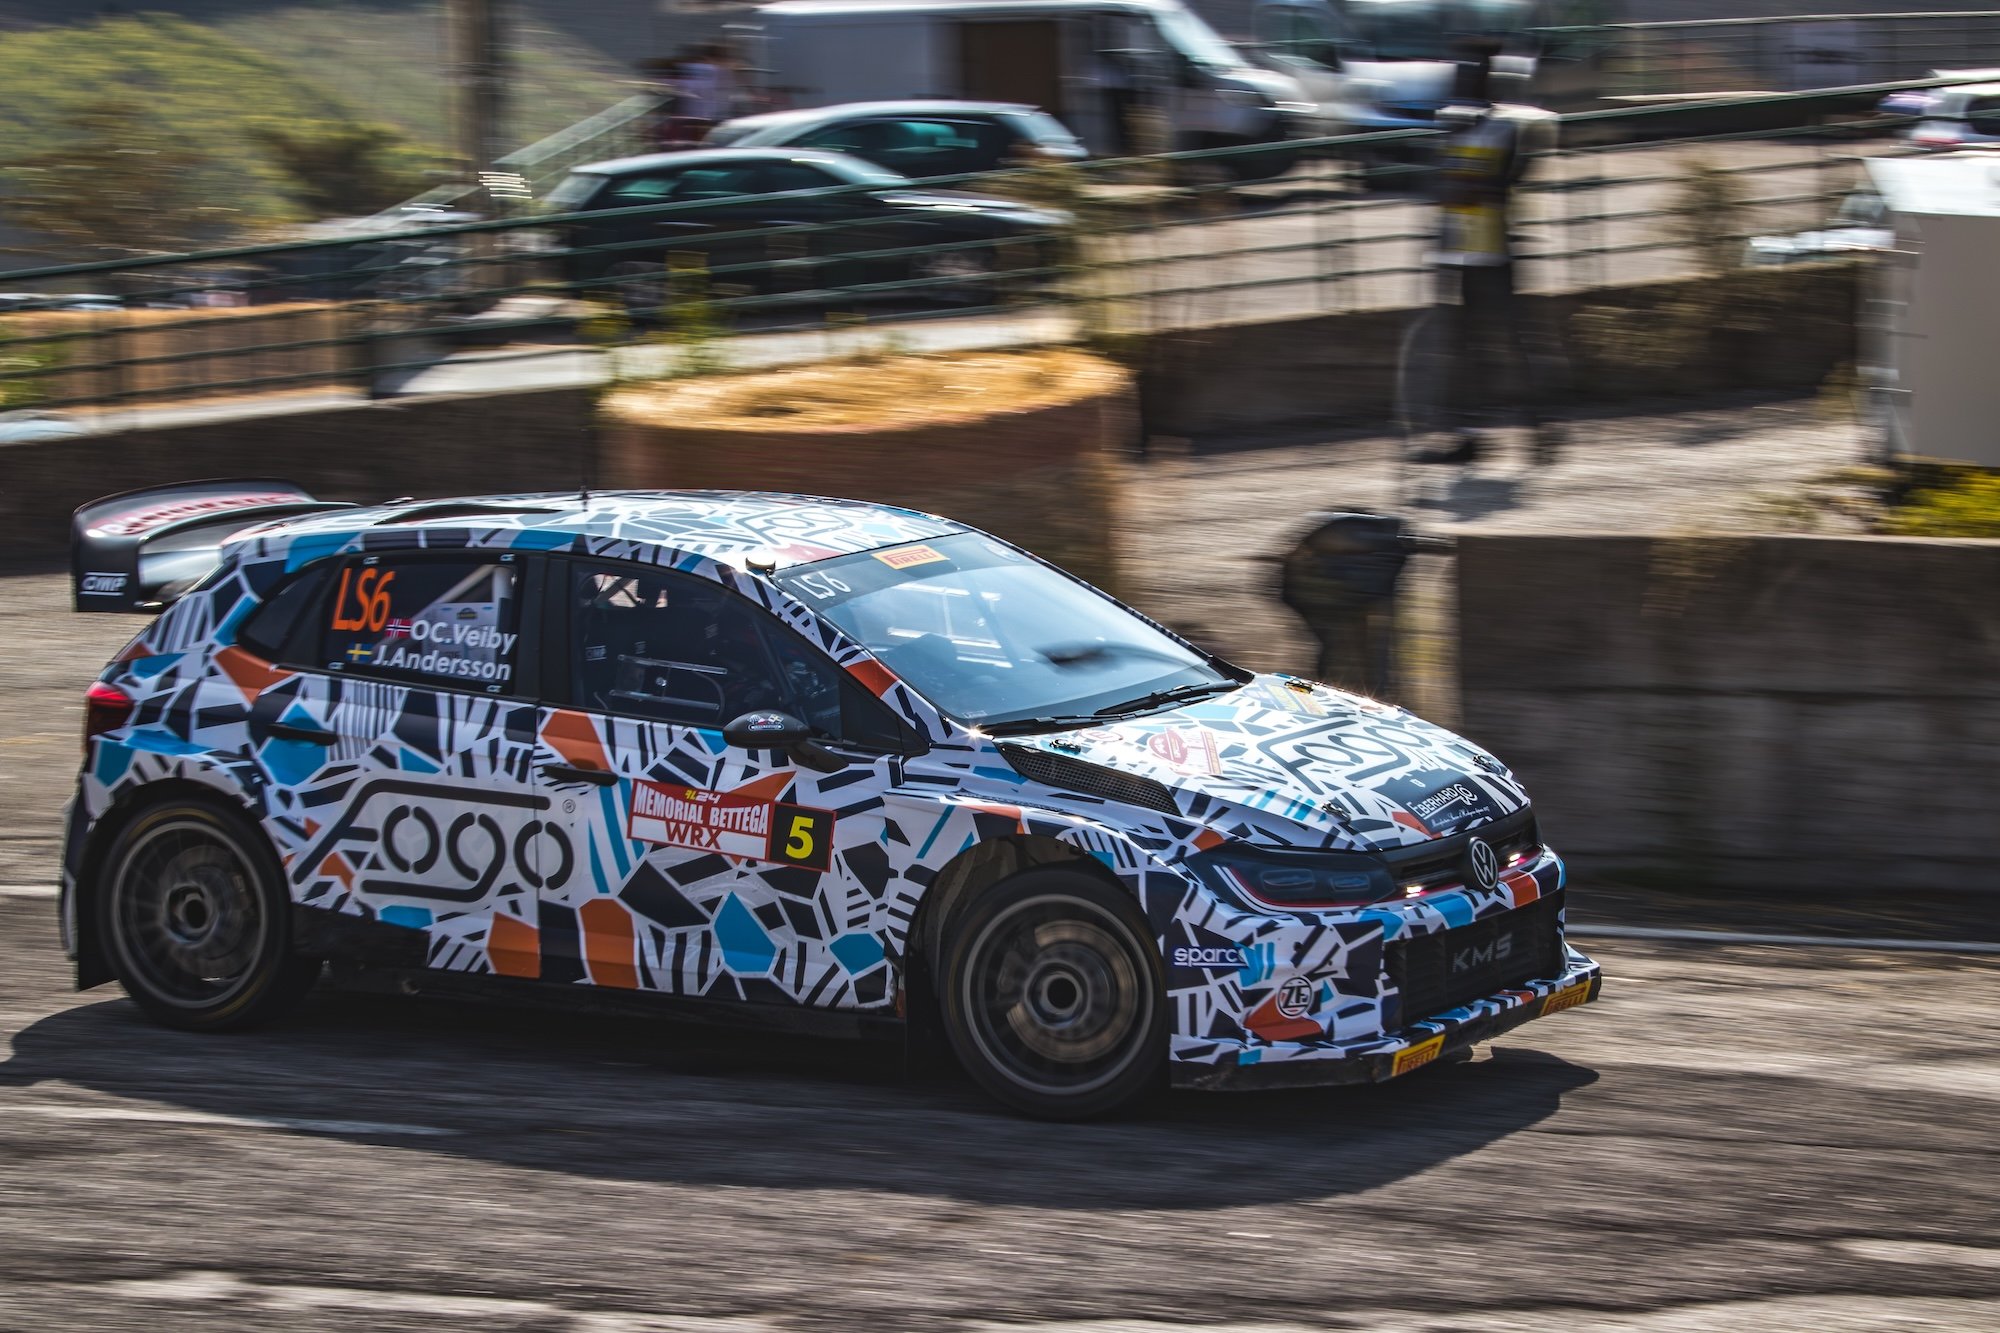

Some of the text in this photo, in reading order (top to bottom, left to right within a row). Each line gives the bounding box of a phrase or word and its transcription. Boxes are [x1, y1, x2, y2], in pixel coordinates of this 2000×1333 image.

[882, 548, 938, 566] PIRELLI
[81, 574, 128, 595] OMP
[332, 567, 396, 632] LS6
[791, 572, 851, 600] LS6
[410, 620, 518, 655] OC.Veiby
[372, 645, 511, 681] J.Andersson
[634, 783, 770, 835] MEMORIAL BETTEGA
[1406, 788, 1459, 817] EBERHARD
[665, 820, 723, 850] WRX
[785, 815, 815, 859] 5
[1452, 932, 1513, 973] KMS
[1281, 985, 1310, 1009] ZF
